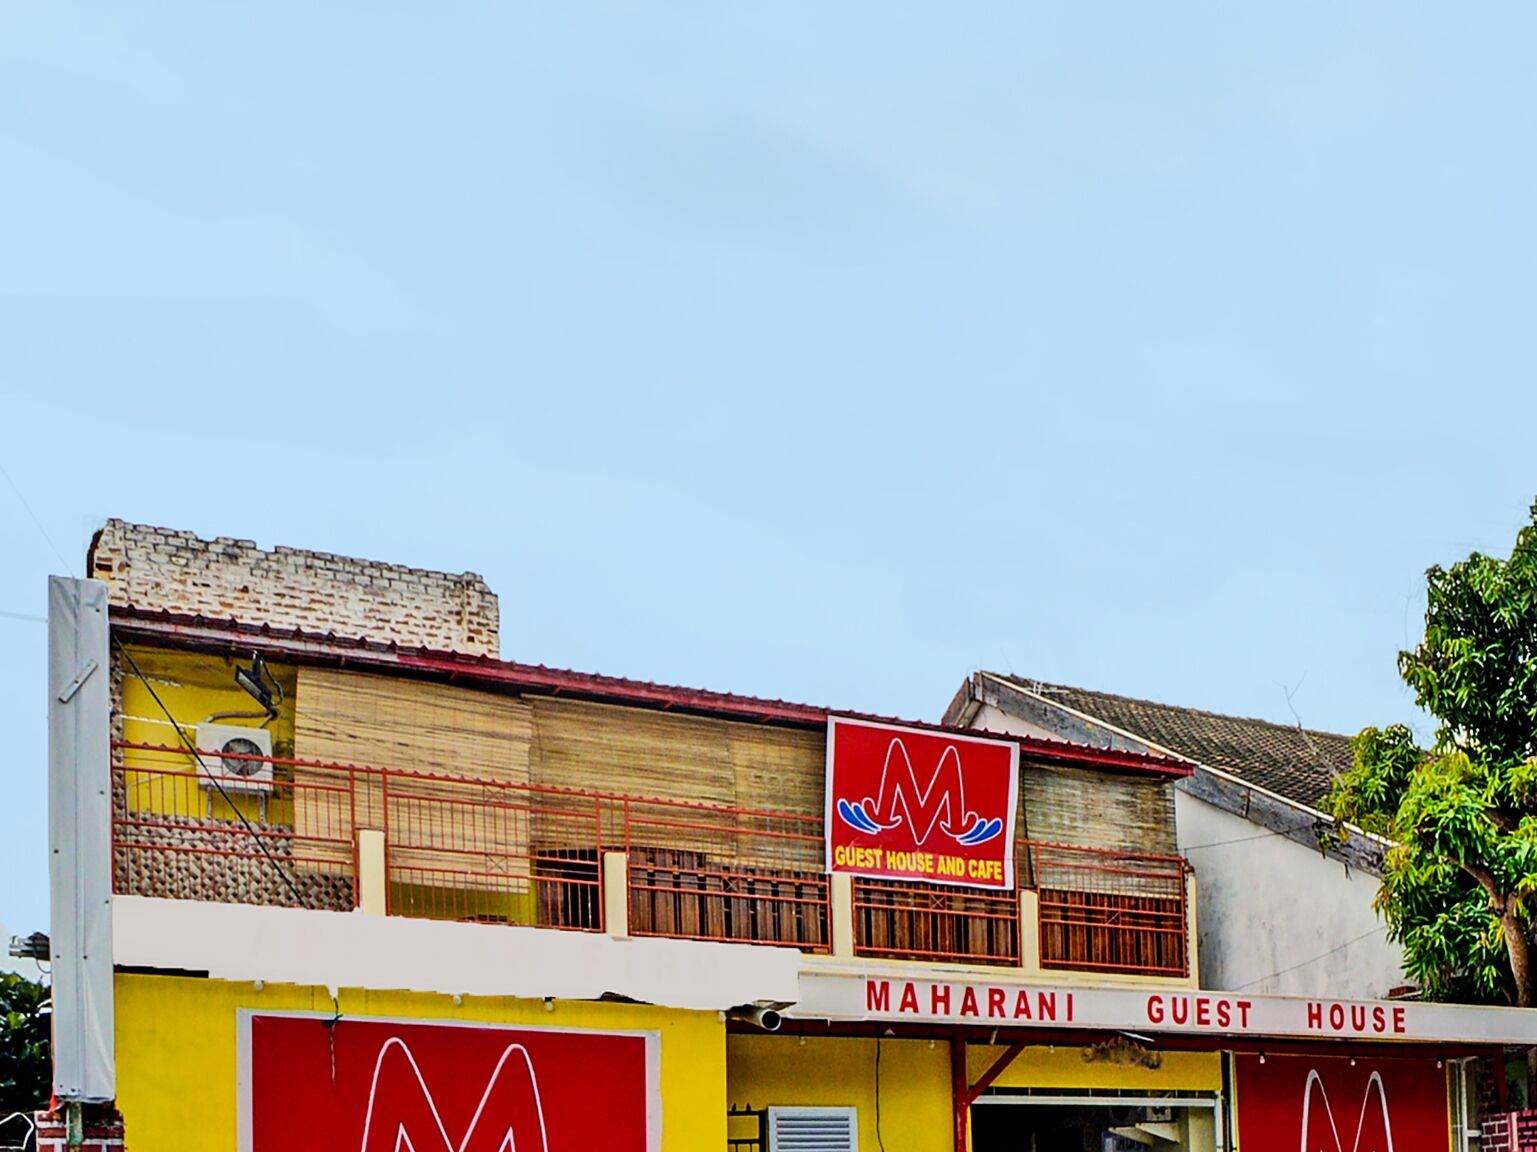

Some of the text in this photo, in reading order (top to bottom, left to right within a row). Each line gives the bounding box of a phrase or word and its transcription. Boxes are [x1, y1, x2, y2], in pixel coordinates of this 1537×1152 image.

[834, 845, 1003, 881] GUEST HOUSE AND CAFE
[866, 980, 1406, 1034] MAHARANI GUEST HOUSE
